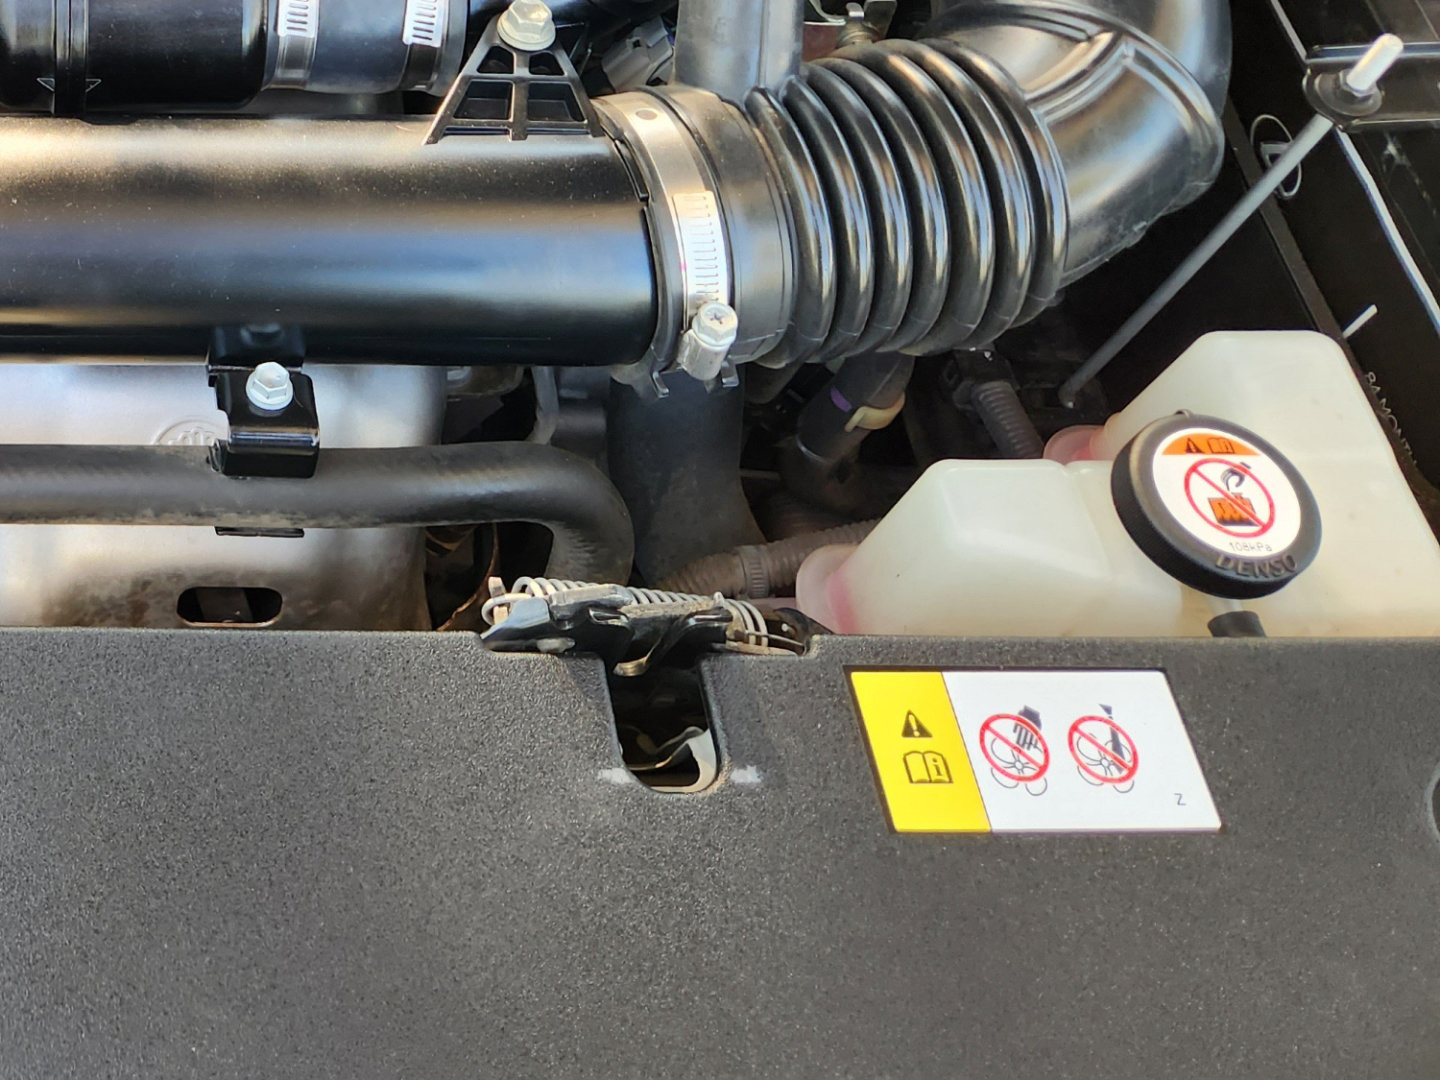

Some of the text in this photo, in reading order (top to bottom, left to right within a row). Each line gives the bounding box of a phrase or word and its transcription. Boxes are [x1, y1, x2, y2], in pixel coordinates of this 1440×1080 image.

[1229, 541, 1273, 552] 108kPa
[1216, 554, 1297, 578] DENSO
[1173, 792, 1187, 806] Z
